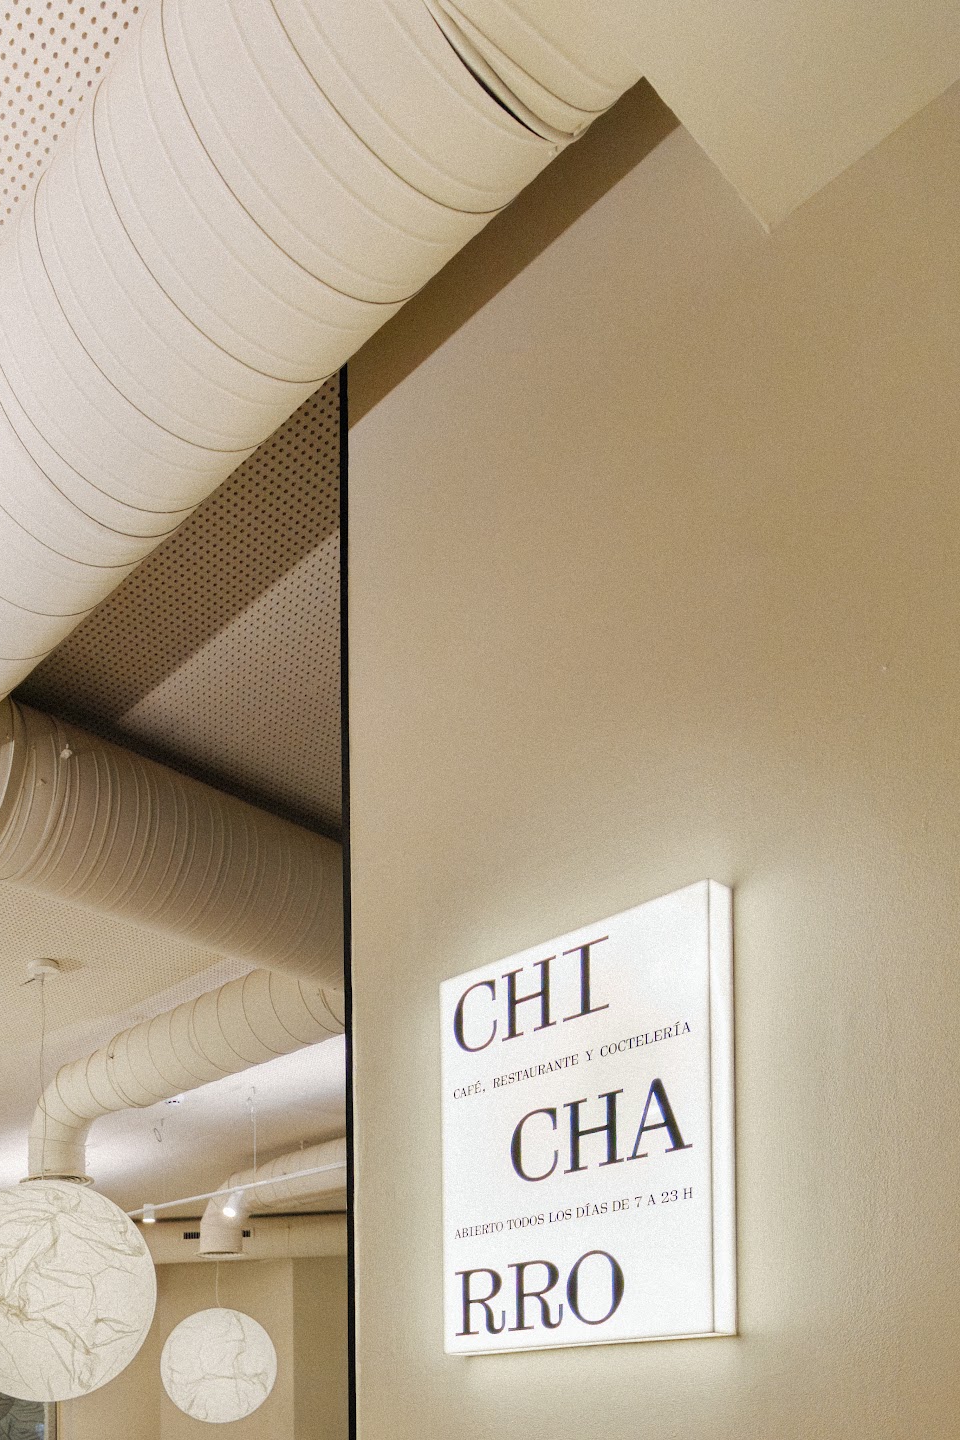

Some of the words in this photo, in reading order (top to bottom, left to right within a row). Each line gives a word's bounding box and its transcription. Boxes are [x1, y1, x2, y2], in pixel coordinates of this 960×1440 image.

[453, 935, 610, 1053] CHI
[453, 1080, 486, 1099] CAFÉ,
[493, 1054, 579, 1089] RESTAURANTE
[585, 1050, 594, 1061] Y
[600, 1021, 691, 1057] COCTELERÍA
[510, 1077, 693, 1183] CHA
[454, 1222, 504, 1239] ABIERTO
[506, 1214, 545, 1230] TODOS
[548, 1209, 572, 1223] LOS
[576, 1203, 608, 1219] DÍAS
[612, 1199, 630, 1212] DE
[634, 1196, 643, 1208] 7
[647, 1194, 656, 1206] A
[661, 1190, 678, 1204] 23
[683, 1187, 693, 1199] H
[454, 1249, 625, 1337] RRO
